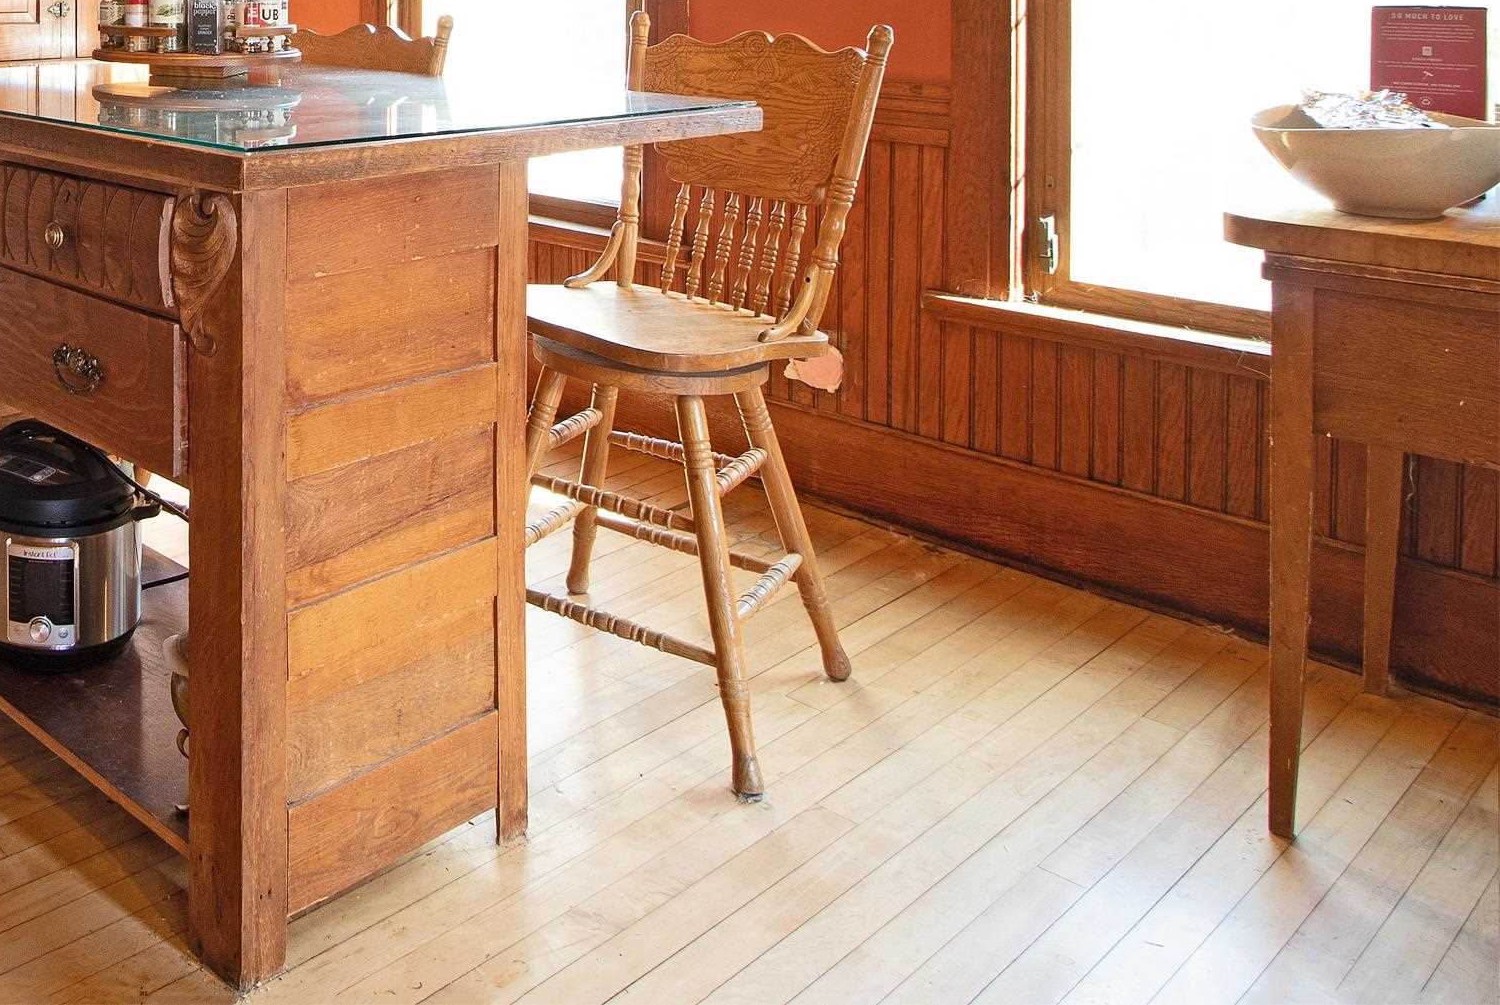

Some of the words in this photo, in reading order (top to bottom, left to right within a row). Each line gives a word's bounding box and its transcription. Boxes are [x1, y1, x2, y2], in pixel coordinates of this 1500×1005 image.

[1404, 12, 1429, 20] MUCH
[1430, 13, 1441, 21] TO
[1443, 13, 1464, 21] LOVE
